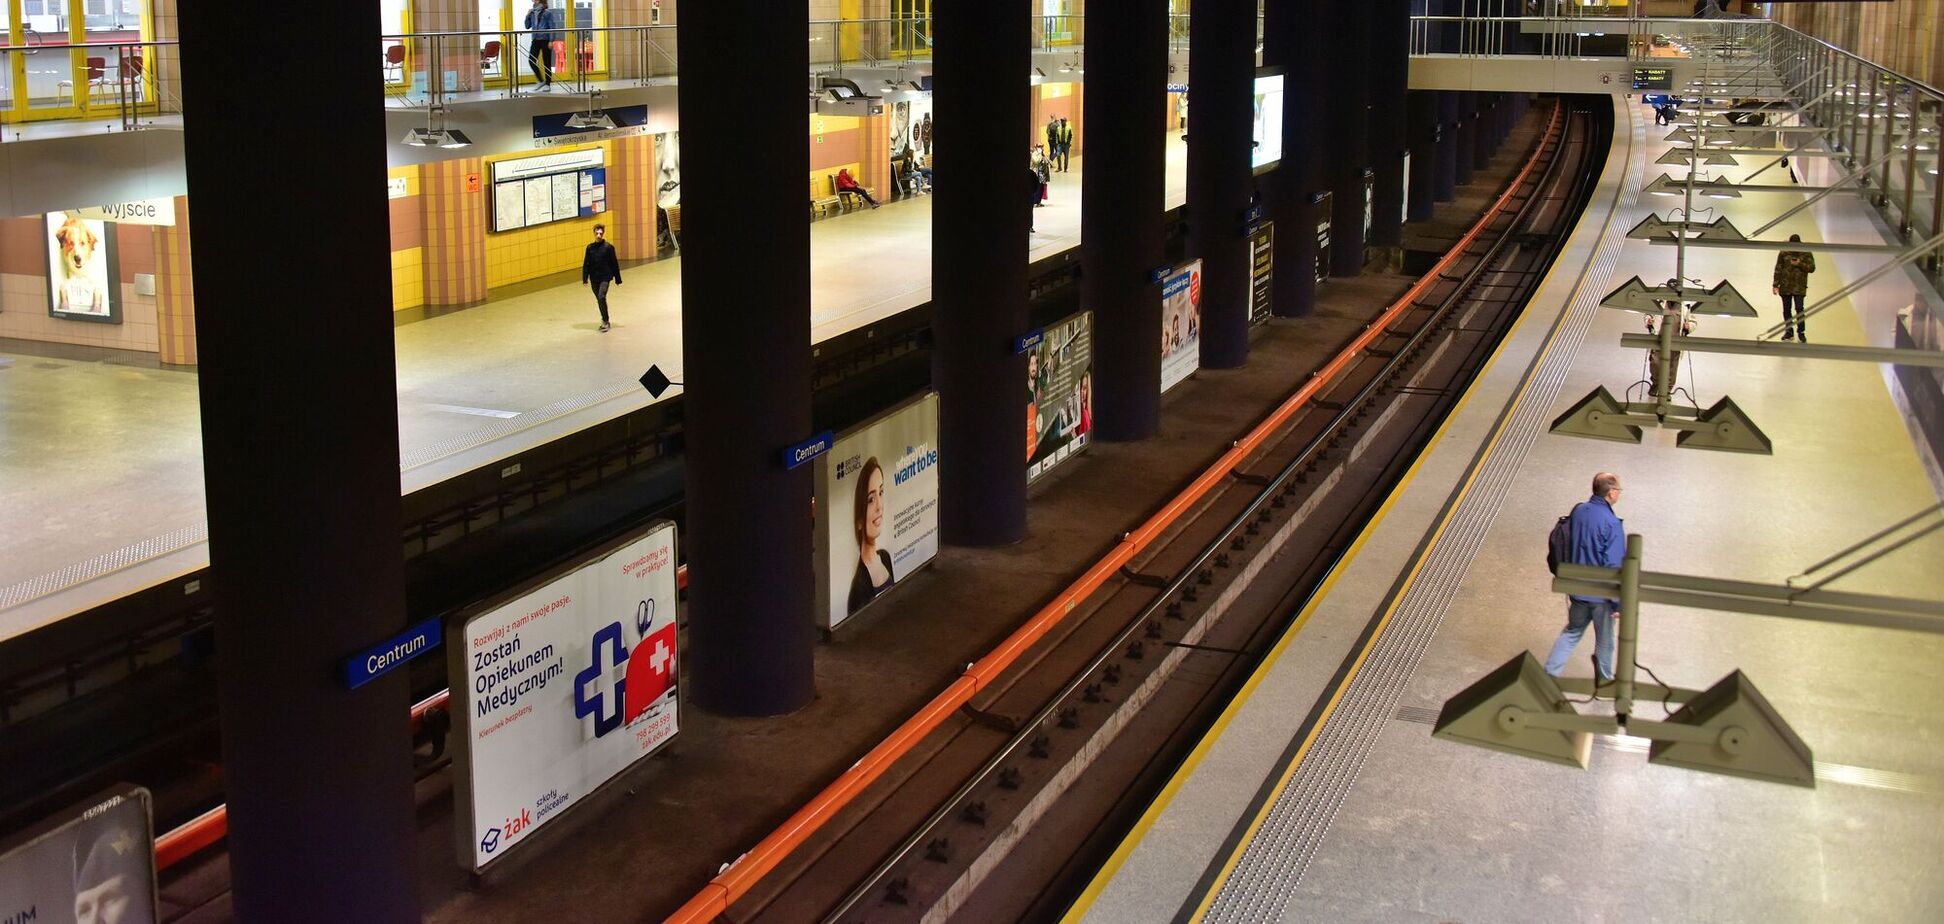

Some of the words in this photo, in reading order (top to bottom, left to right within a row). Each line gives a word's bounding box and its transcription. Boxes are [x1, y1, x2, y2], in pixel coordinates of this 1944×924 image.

[1022, 335, 1040, 349] Centrum
[795, 440, 825, 462] Centrum
[894, 459, 917, 486] want
[917, 456, 926, 473] to
[926, 450, 937, 466] be
[623, 550, 659, 575] Sprawdzamy
[659, 545, 669, 556] się
[641, 556, 669, 578] praktyce!
[473, 627, 505, 648] Rozwijaj
[506, 624, 510, 633] z
[511, 615, 530, 631] nami
[530, 603, 550, 621] swoje
[550, 595, 572, 612] pasje.
[367, 634, 426, 674] Centrum
[474, 633, 521, 672] Zostań
[476, 644, 553, 694] Opiekunem
[477, 656, 564, 718] Medycznym!
[478, 719, 505, 739] Kierunek
[505, 703, 533, 725] bezpłatny
[536, 789, 557, 807] szkoły
[536, 793, 569, 820] policealne
[504, 807, 531, 840] żak
